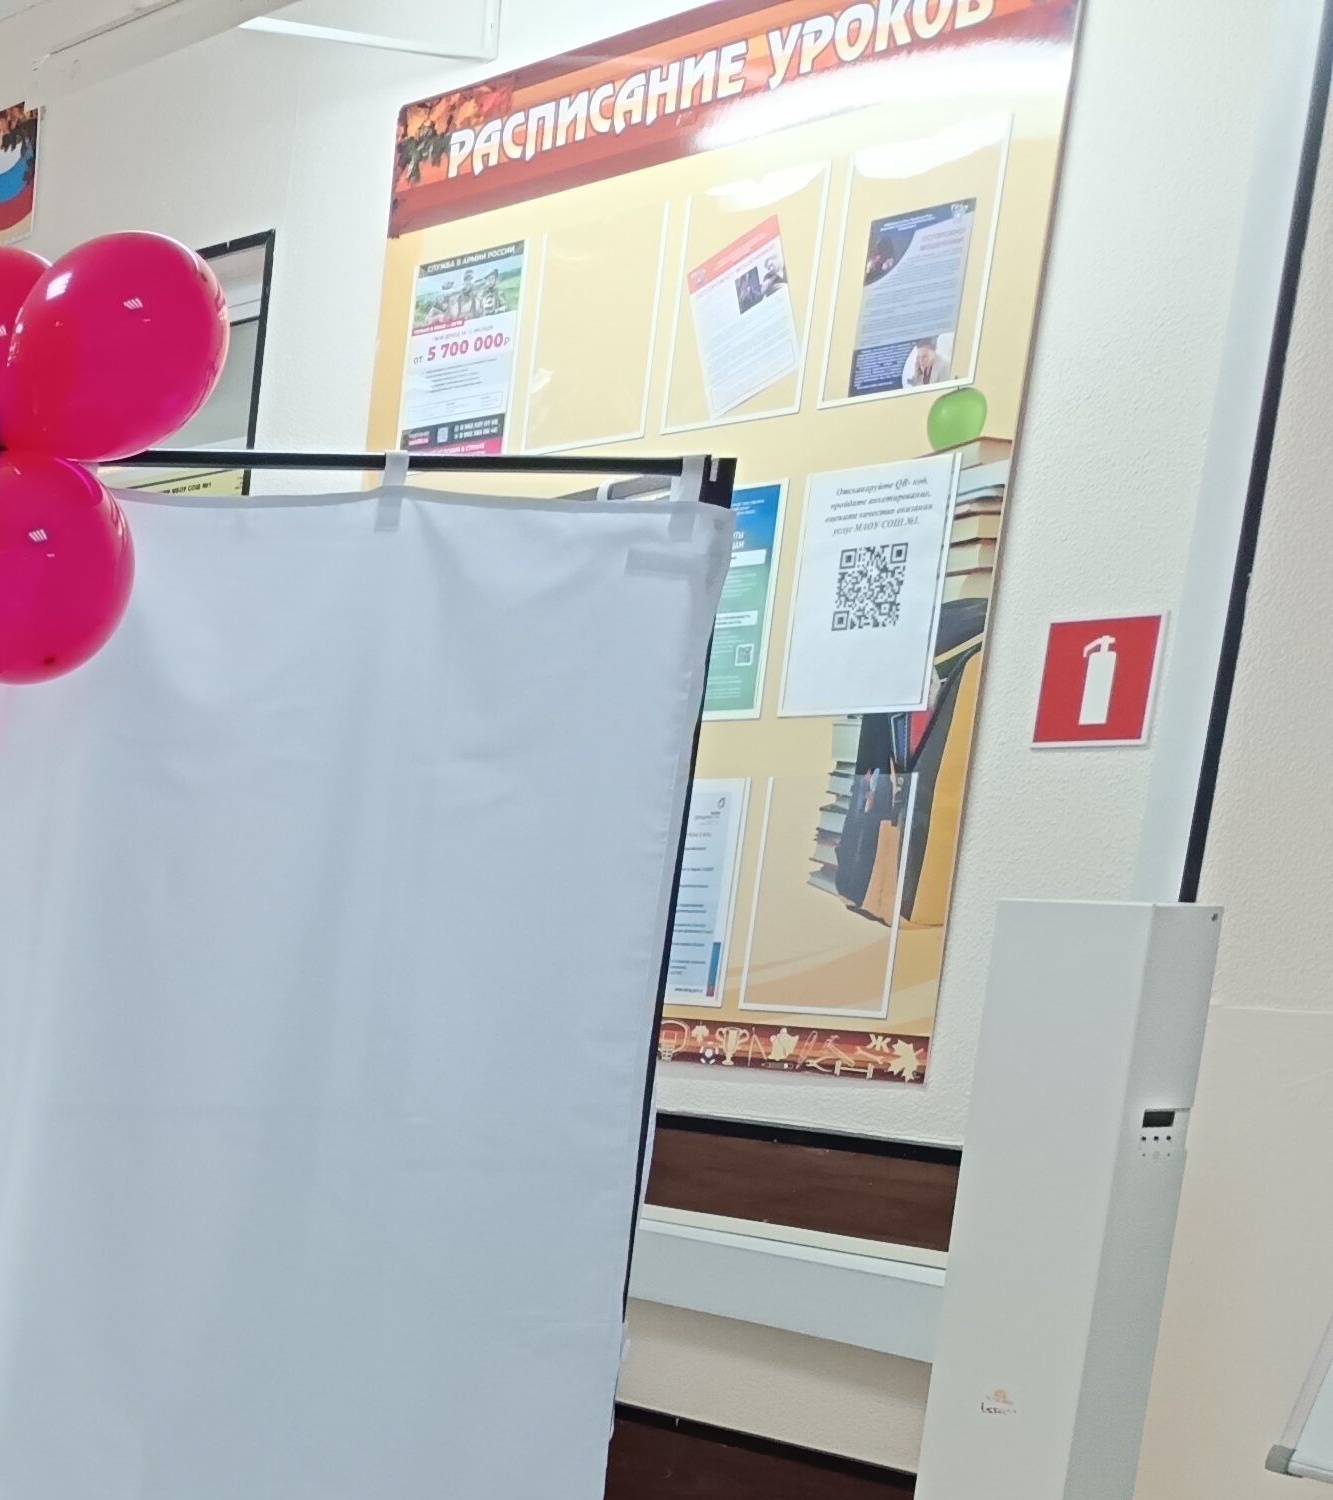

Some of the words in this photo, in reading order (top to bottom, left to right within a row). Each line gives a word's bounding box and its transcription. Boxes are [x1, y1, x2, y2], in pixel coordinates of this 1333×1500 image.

[447, 40, 747, 179] РАСПИСАНИЕ
[767, 0, 995, 90] УРОКОВ
[427, 260, 455, 273] СЛУЖБА
[487, 245, 515, 258] РОССИИ
[427, 346, 436, 361] 5
[440, 339, 469, 359] 700
[836, 482, 894, 496] Отсканируйте
[854, 521, 879, 532] МАОУ
[881, 518, 904, 529] СОШ
